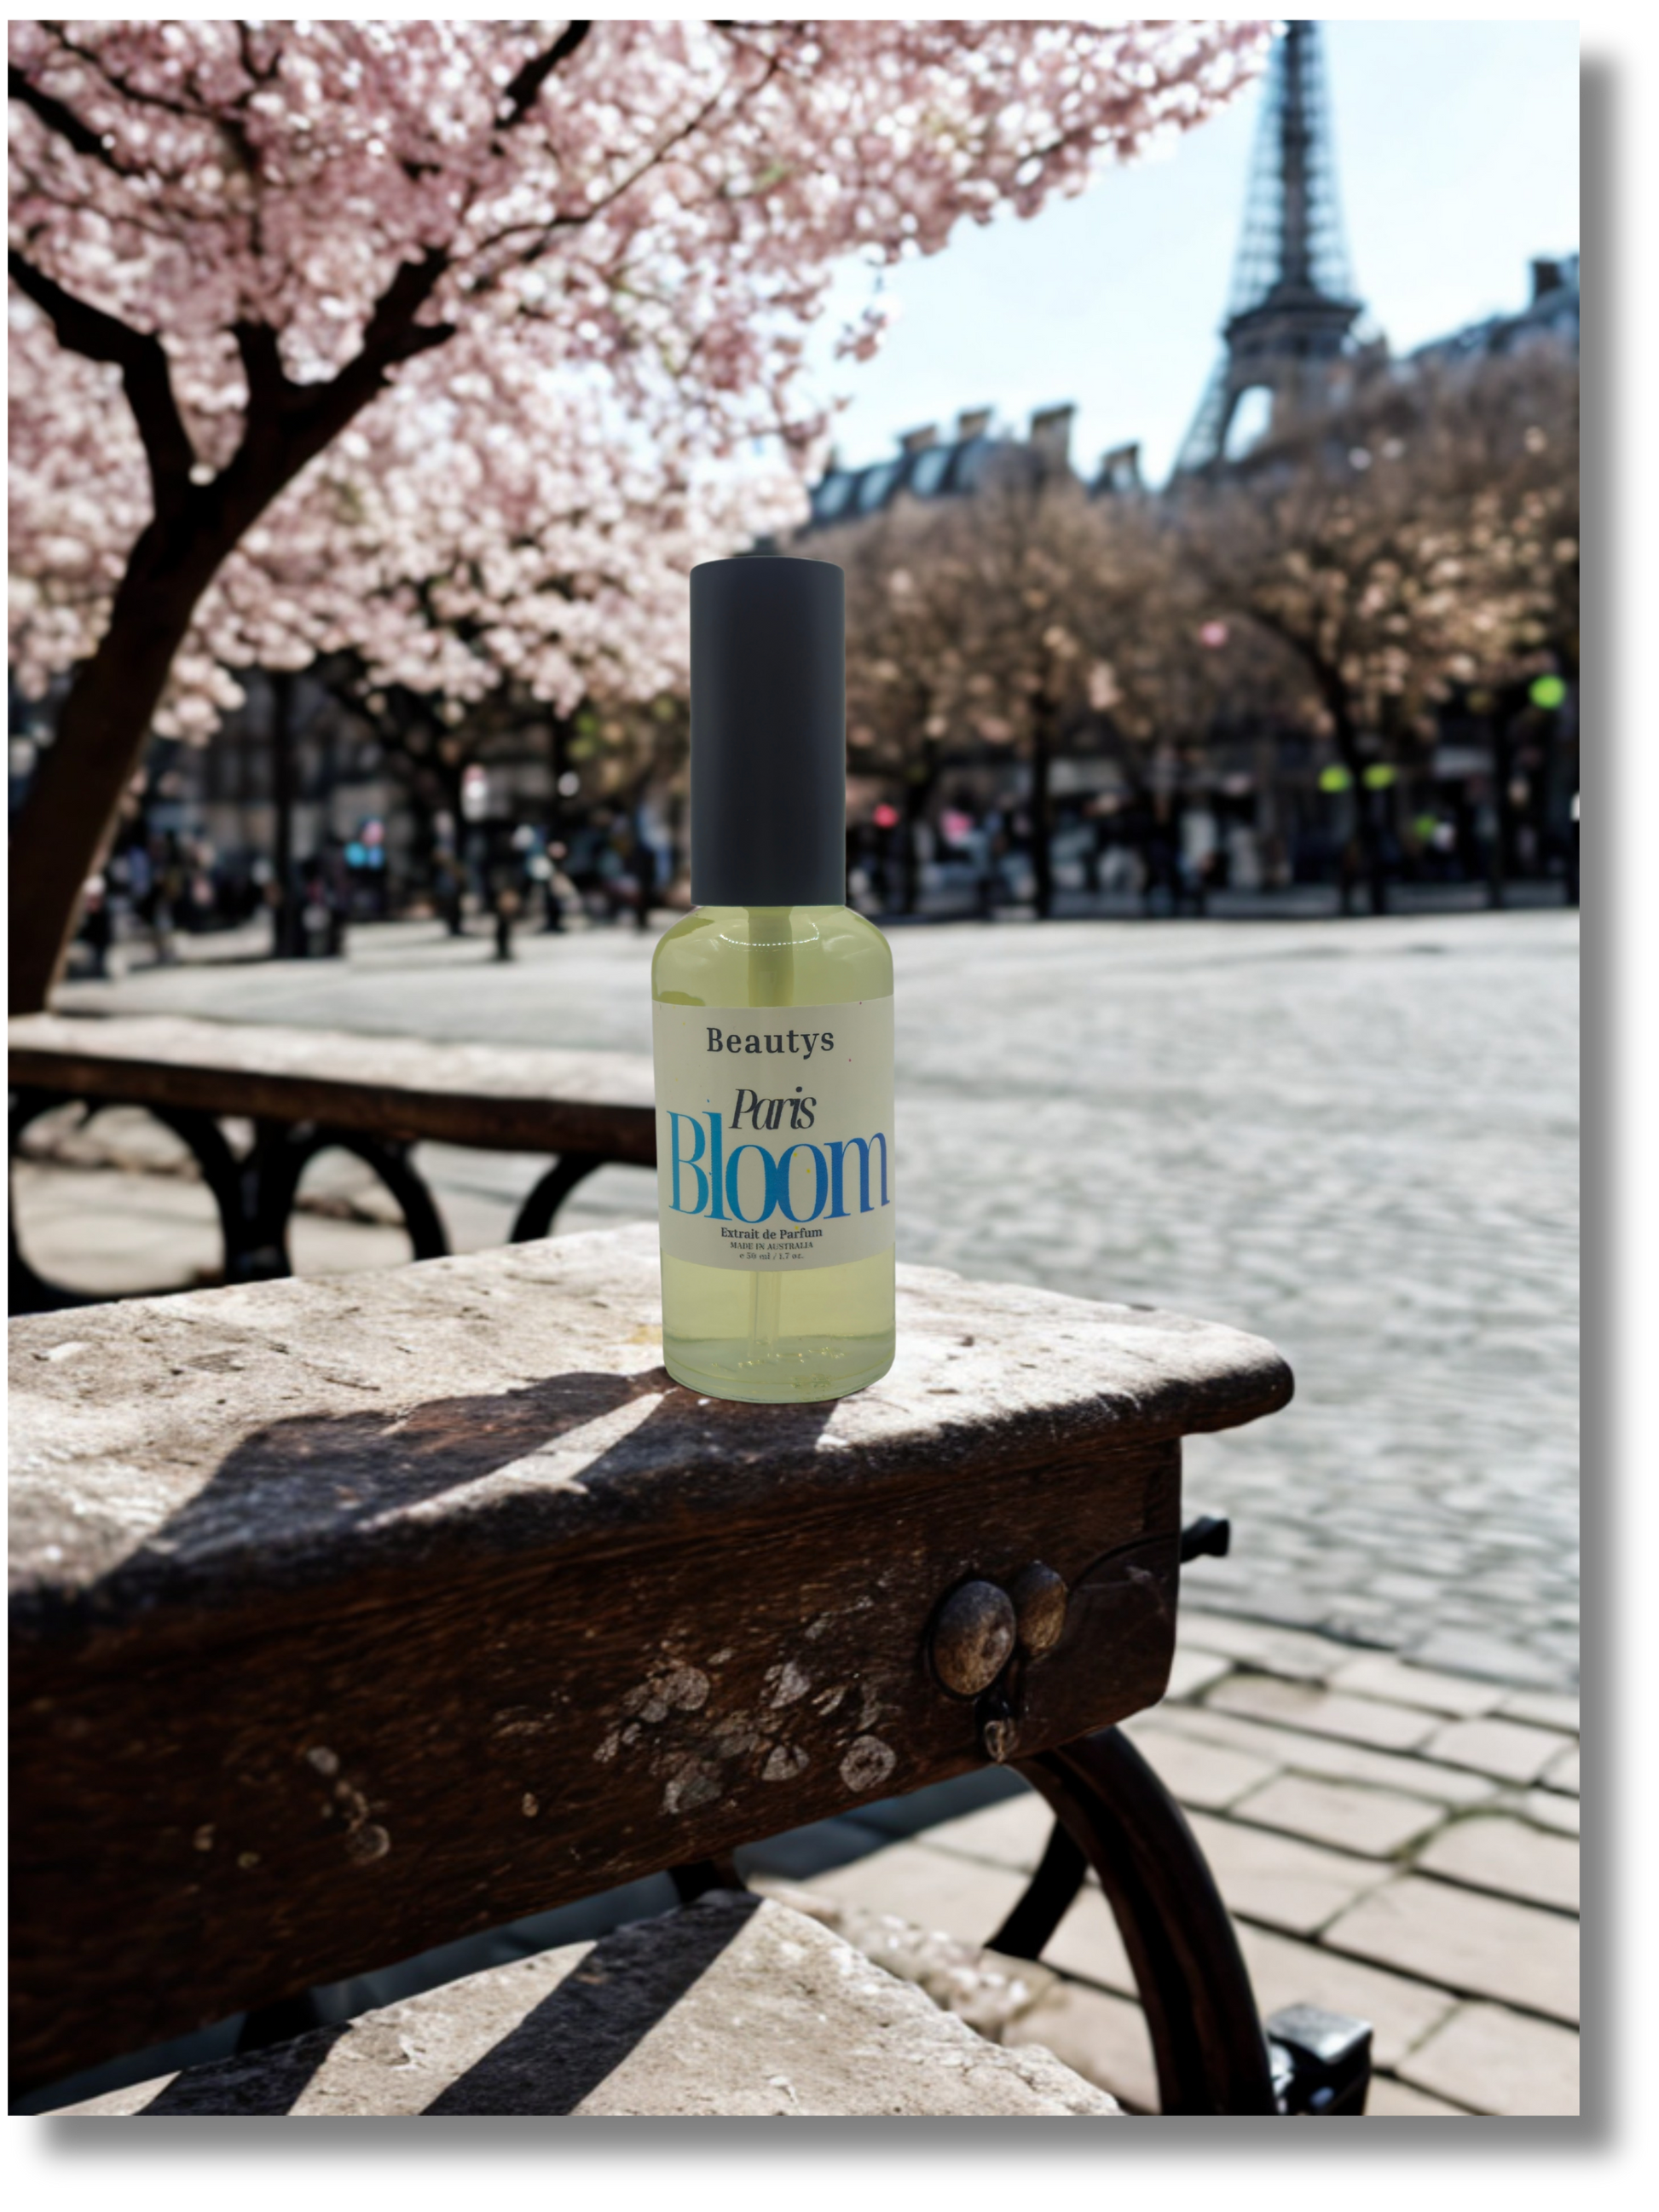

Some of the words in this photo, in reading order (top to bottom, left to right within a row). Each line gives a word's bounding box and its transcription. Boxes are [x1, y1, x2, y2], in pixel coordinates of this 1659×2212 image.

[706, 1026, 835, 1060] Beautys
[728, 1086, 818, 1130] Paris
[666, 1110, 890, 1224] Bloom
[720, 1227, 760, 1239] Extrait
[762, 1228, 777, 1239] de
[779, 1227, 824, 1239] Parfum
[730, 1241, 754, 1250] MADE
[755, 1242, 766, 1250] IN
[766, 1241, 813, 1250] AUSTRALIA
